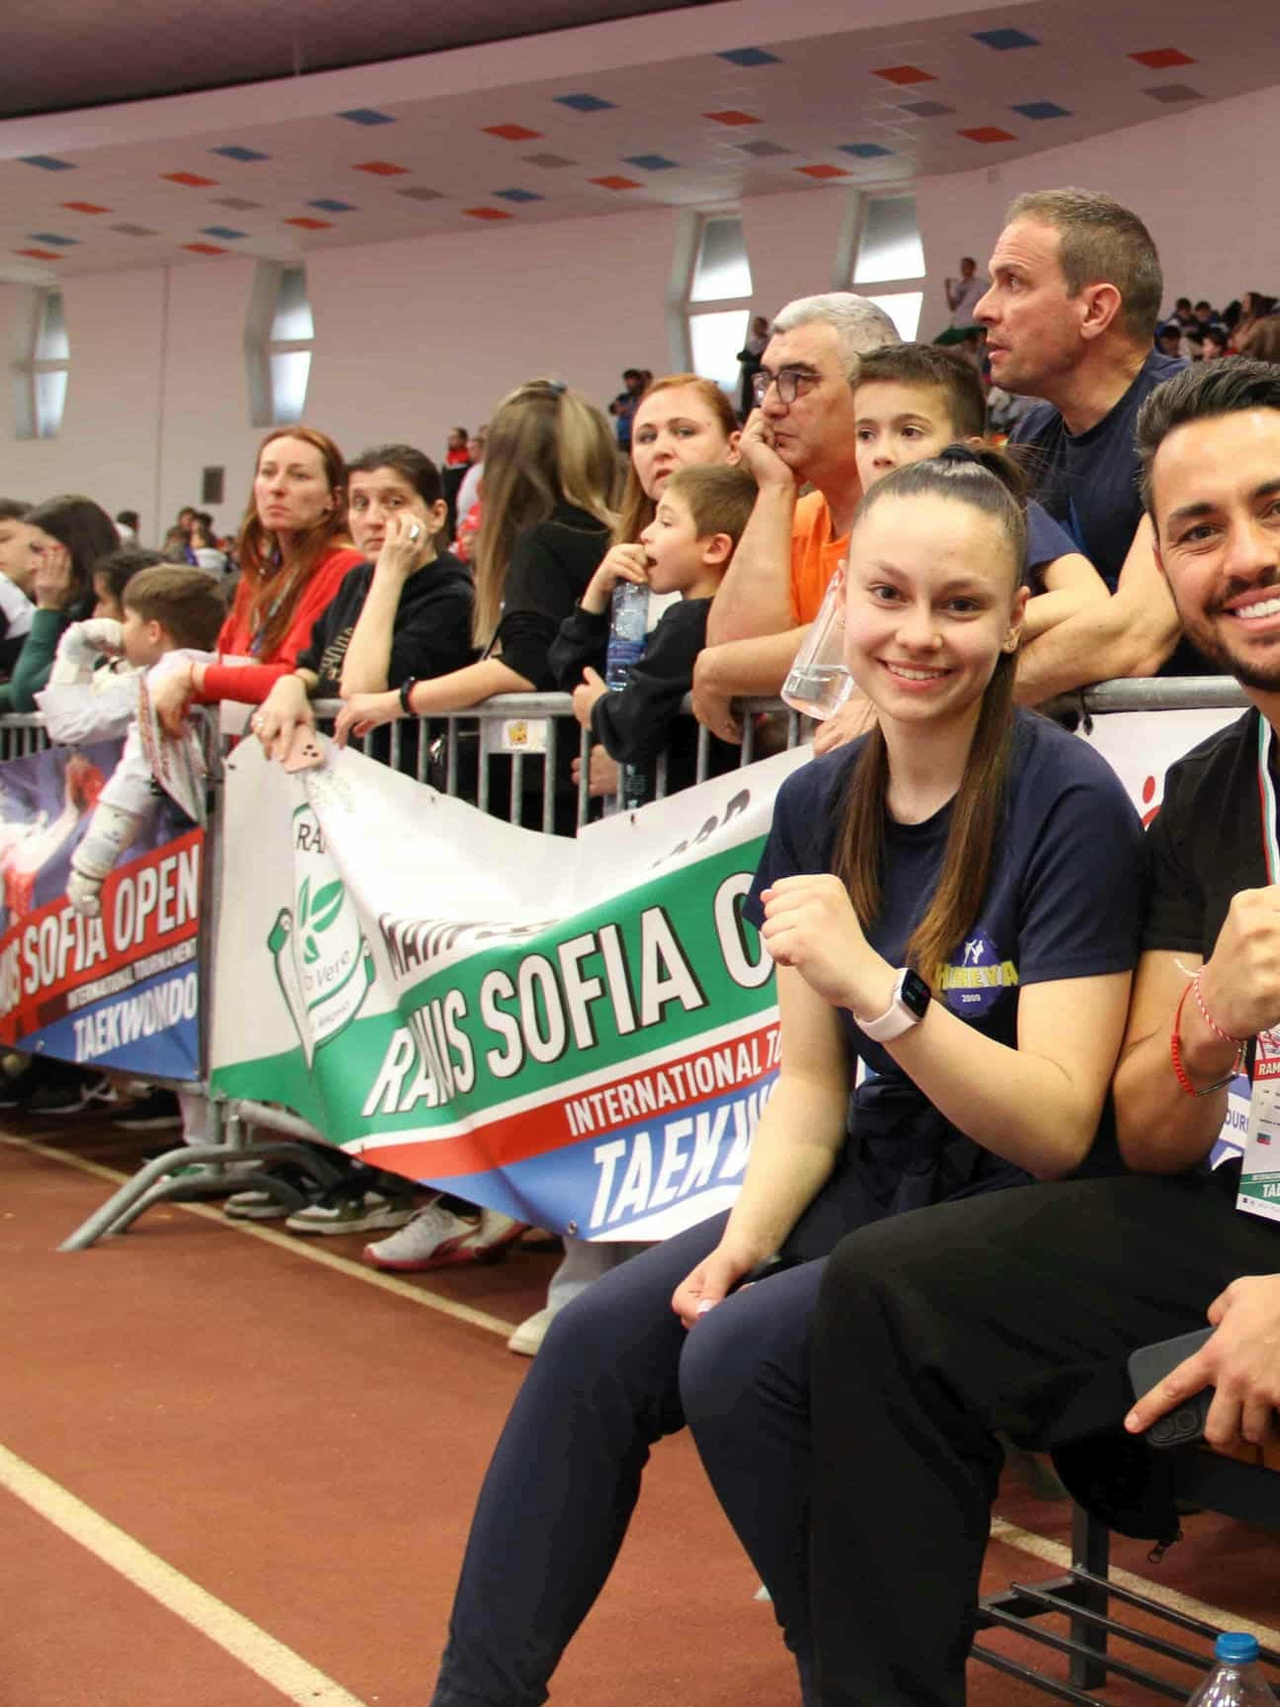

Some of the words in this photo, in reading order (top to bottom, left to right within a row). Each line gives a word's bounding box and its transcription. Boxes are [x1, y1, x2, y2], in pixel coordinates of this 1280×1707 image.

[23, 905, 108, 995] SOFIA
[113, 843, 199, 952] OPEN
[73, 971, 198, 1063] TAEKWONDO
[480, 906, 709, 1078] SOFIA
[564, 1038, 763, 1138] INTERNATIONAL
[766, 1029, 781, 1069] T
